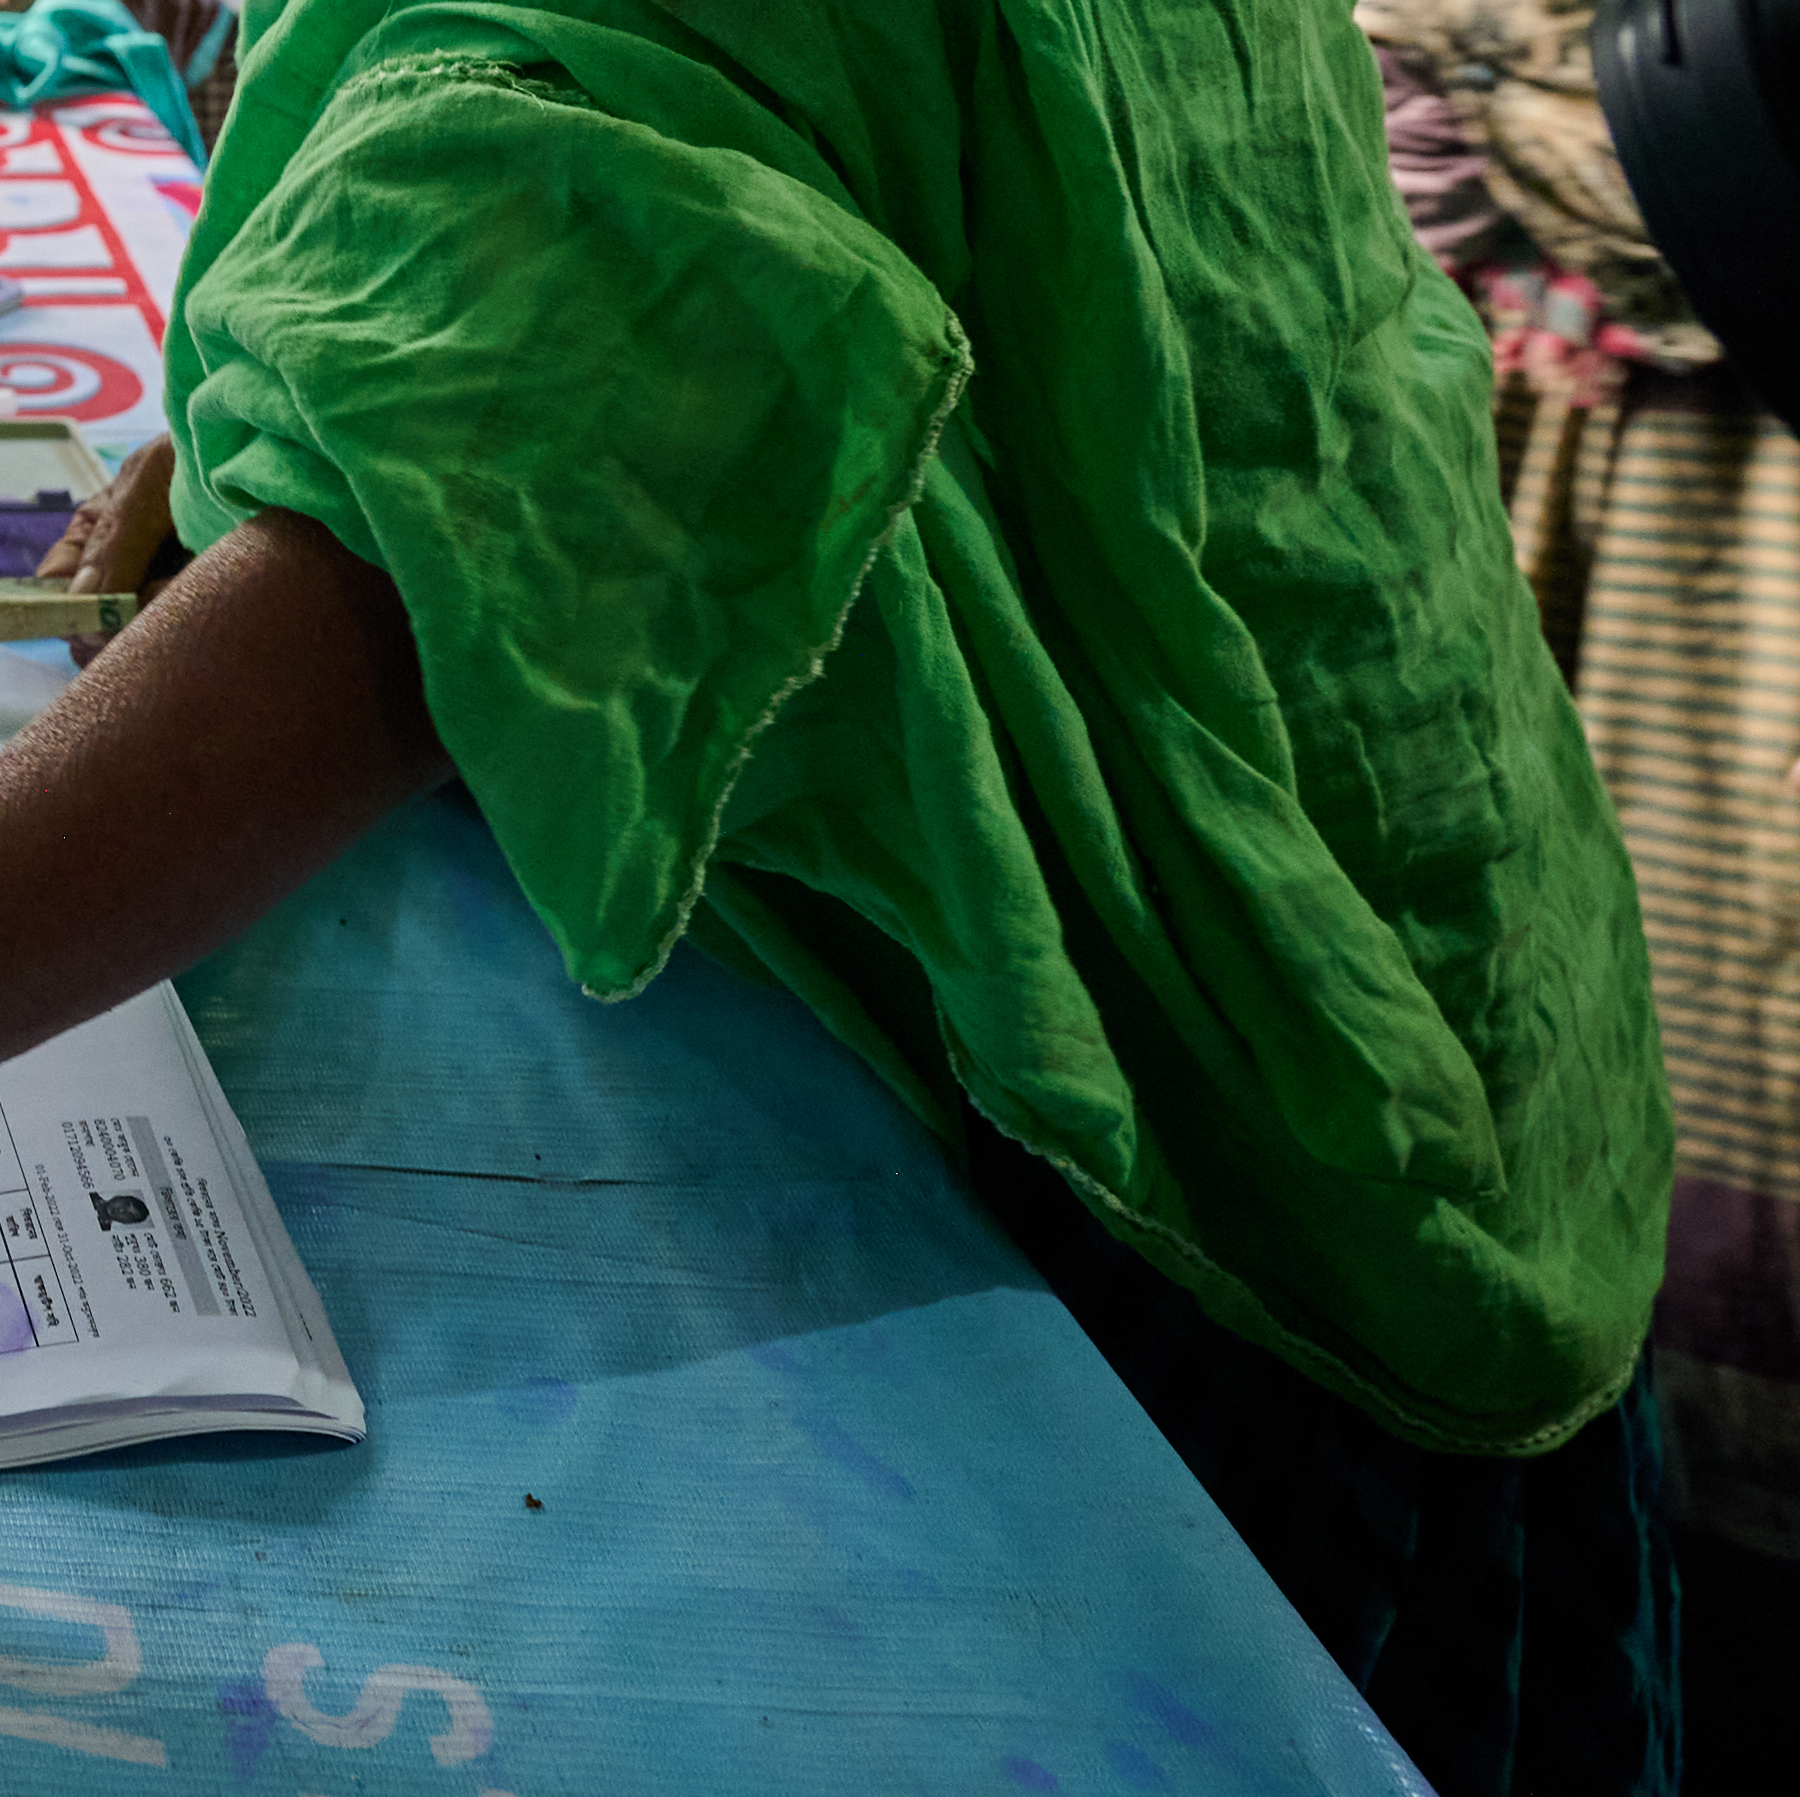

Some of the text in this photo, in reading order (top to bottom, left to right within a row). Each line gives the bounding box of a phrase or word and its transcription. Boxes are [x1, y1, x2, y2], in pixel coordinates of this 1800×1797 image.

[116, 1255, 134, 1275] 282
[134, 1256, 151, 1276] 380
[214, 1231, 257, 1317] November/2022
[160, 1278, 176, 1298] 662
